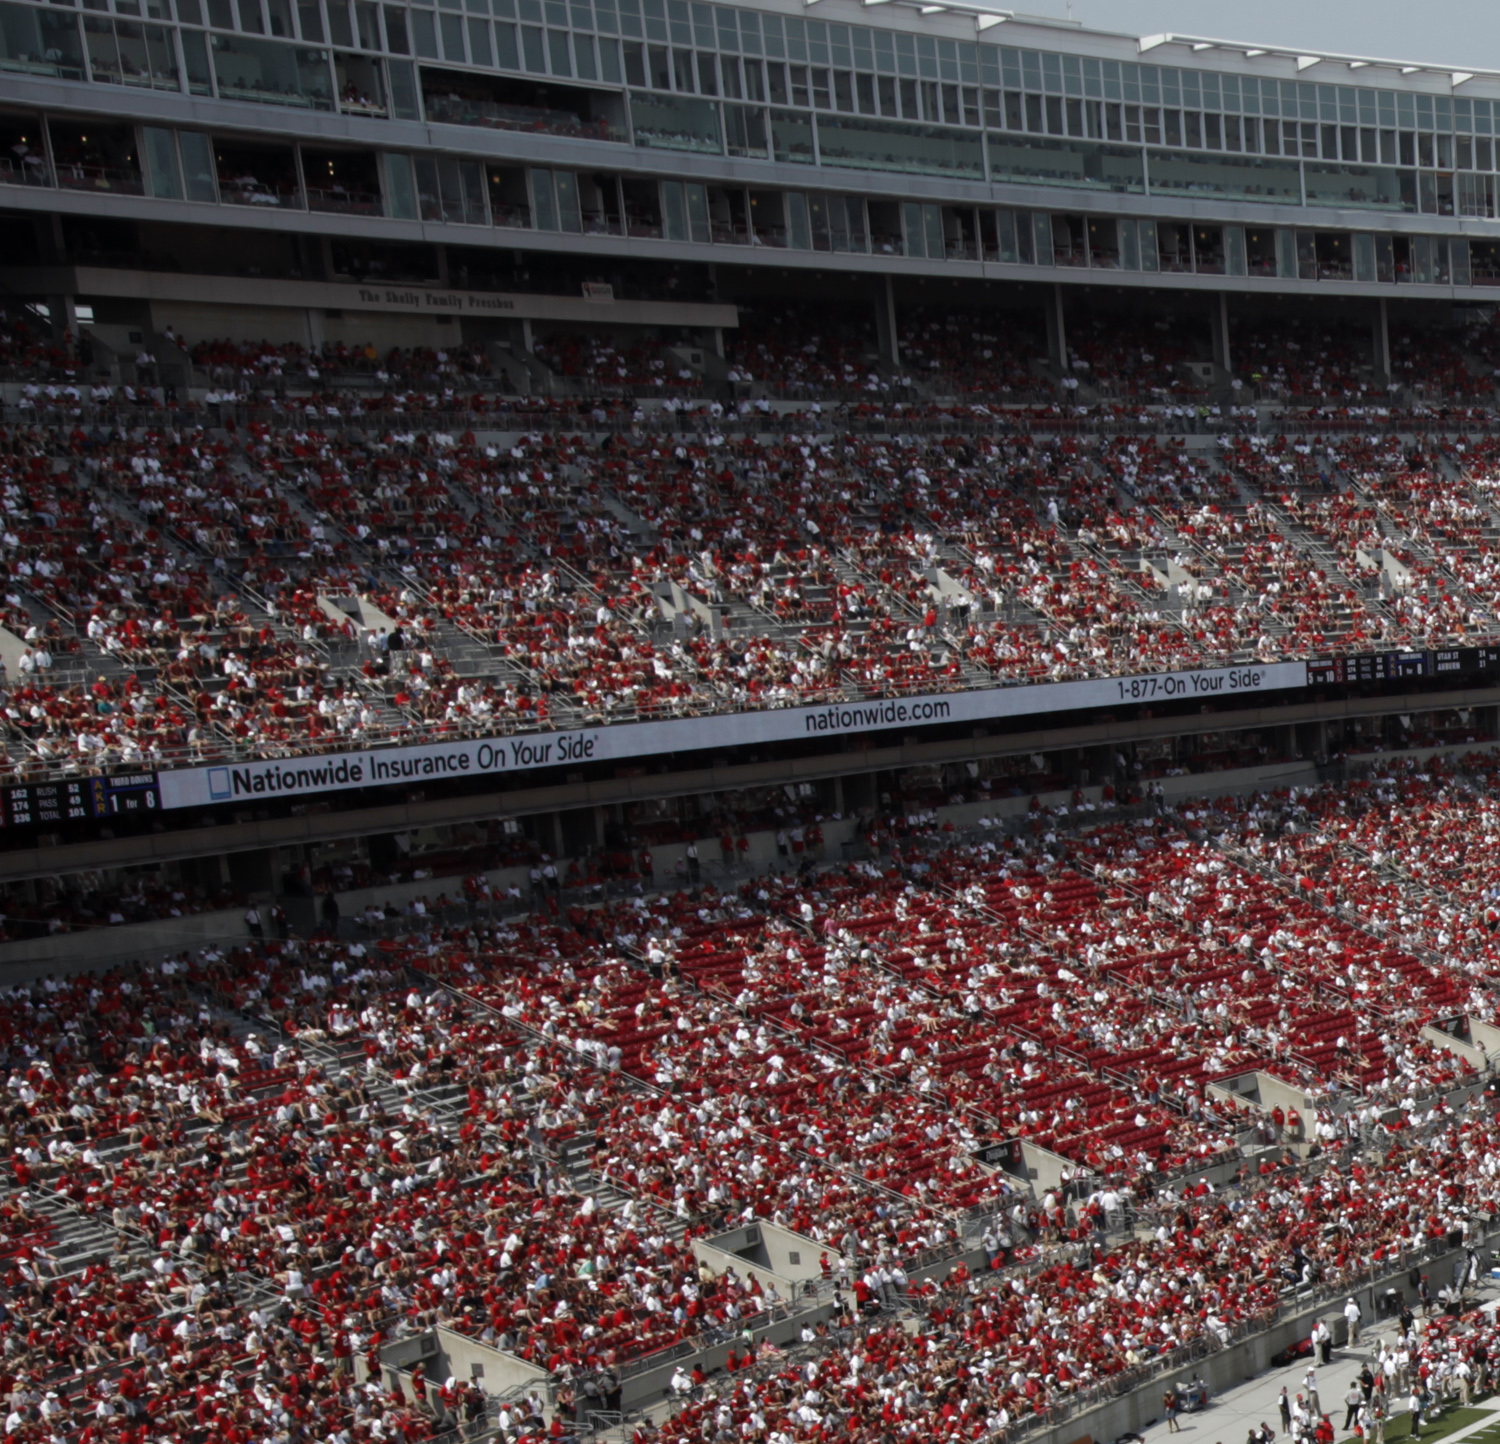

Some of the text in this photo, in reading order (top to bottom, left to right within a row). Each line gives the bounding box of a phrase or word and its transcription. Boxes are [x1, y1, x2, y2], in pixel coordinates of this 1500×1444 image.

[1118, 676, 1185, 700] 1-877-On
[1190, 674, 1224, 694] Your
[805, 699, 950, 732] nationwide.com
[370, 751, 470, 781] Insurance
[477, 743, 506, 770] On
[510, 737, 552, 766] Your
[11, 784, 79, 799] 162 RUSH 52
[110, 791, 155, 812] 1 for 8
[13, 795, 81, 812] 174 PASS 49
[40, 811, 61, 820] TOTAL
[69, 807, 86, 817] 101
